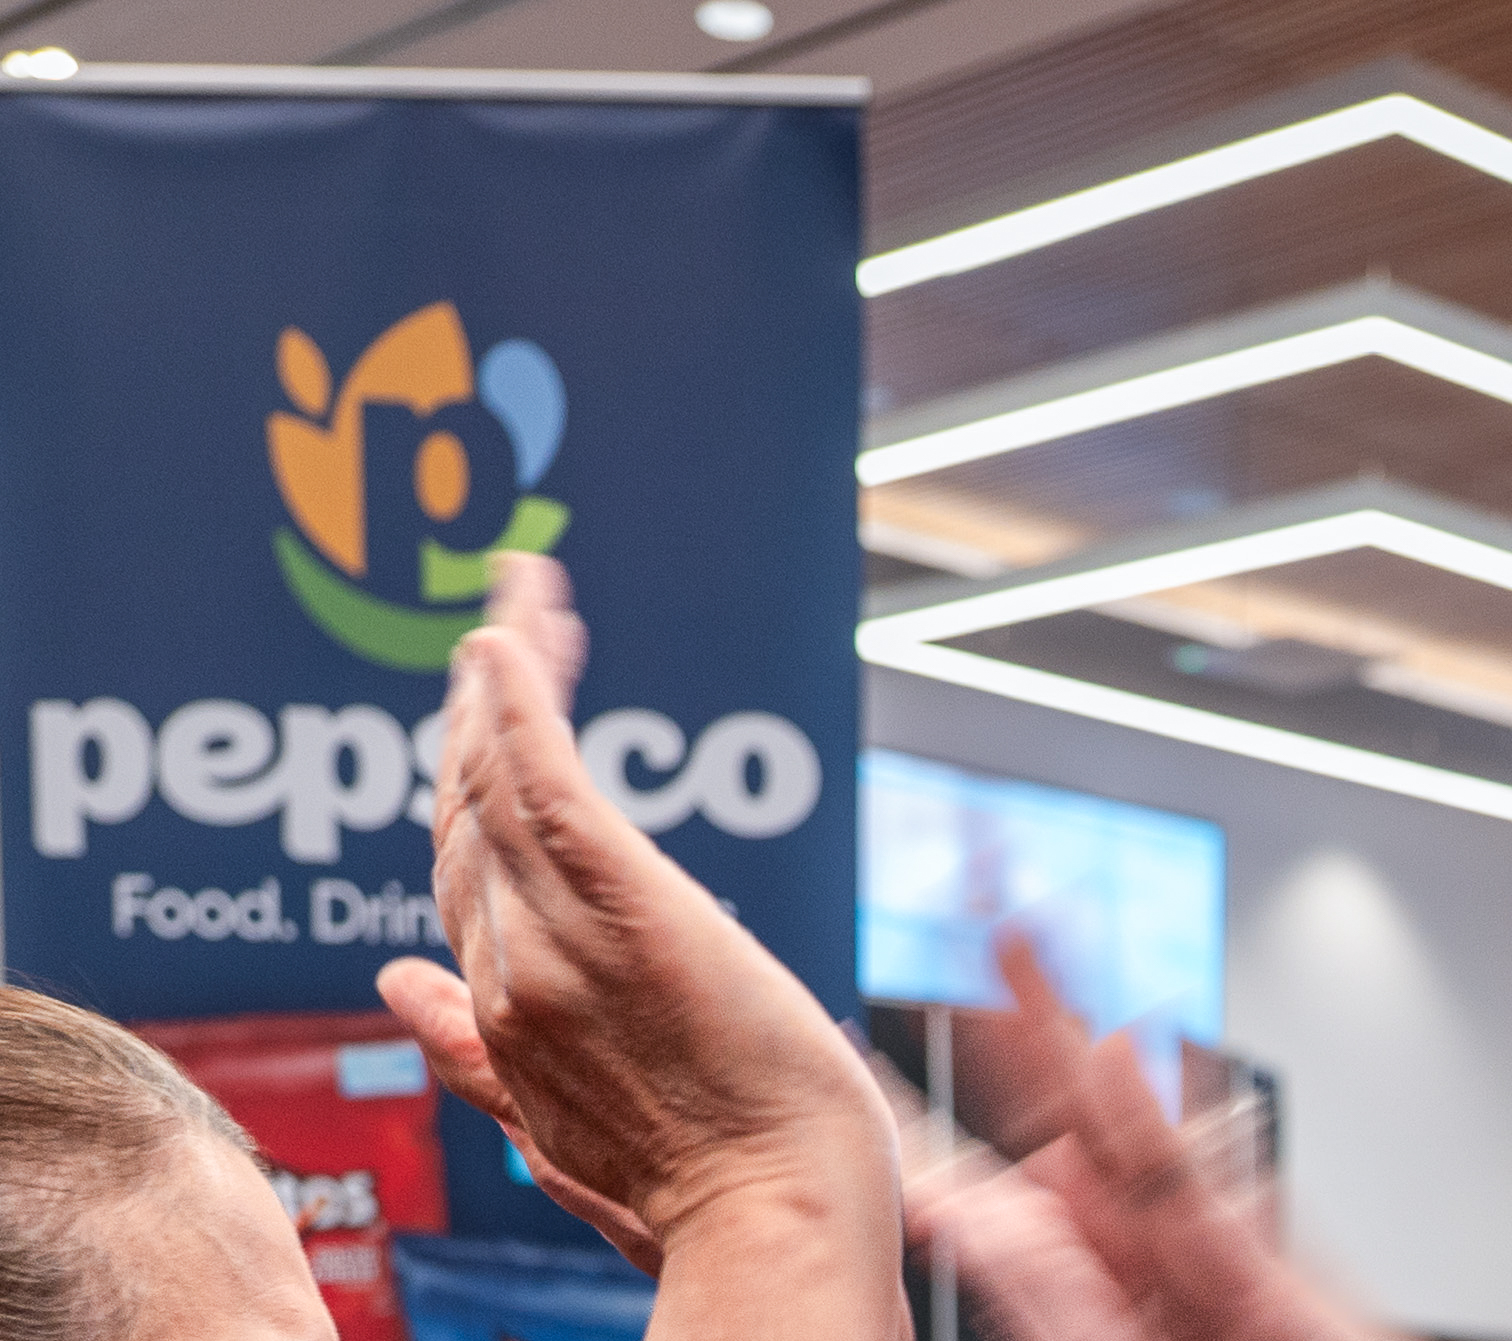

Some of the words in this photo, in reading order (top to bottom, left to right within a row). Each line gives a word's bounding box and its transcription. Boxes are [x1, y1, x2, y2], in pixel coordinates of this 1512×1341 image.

[28, 698, 823, 864] pepco
[111, 872, 299, 944] Food.
[310, 878, 451, 947] Drin
